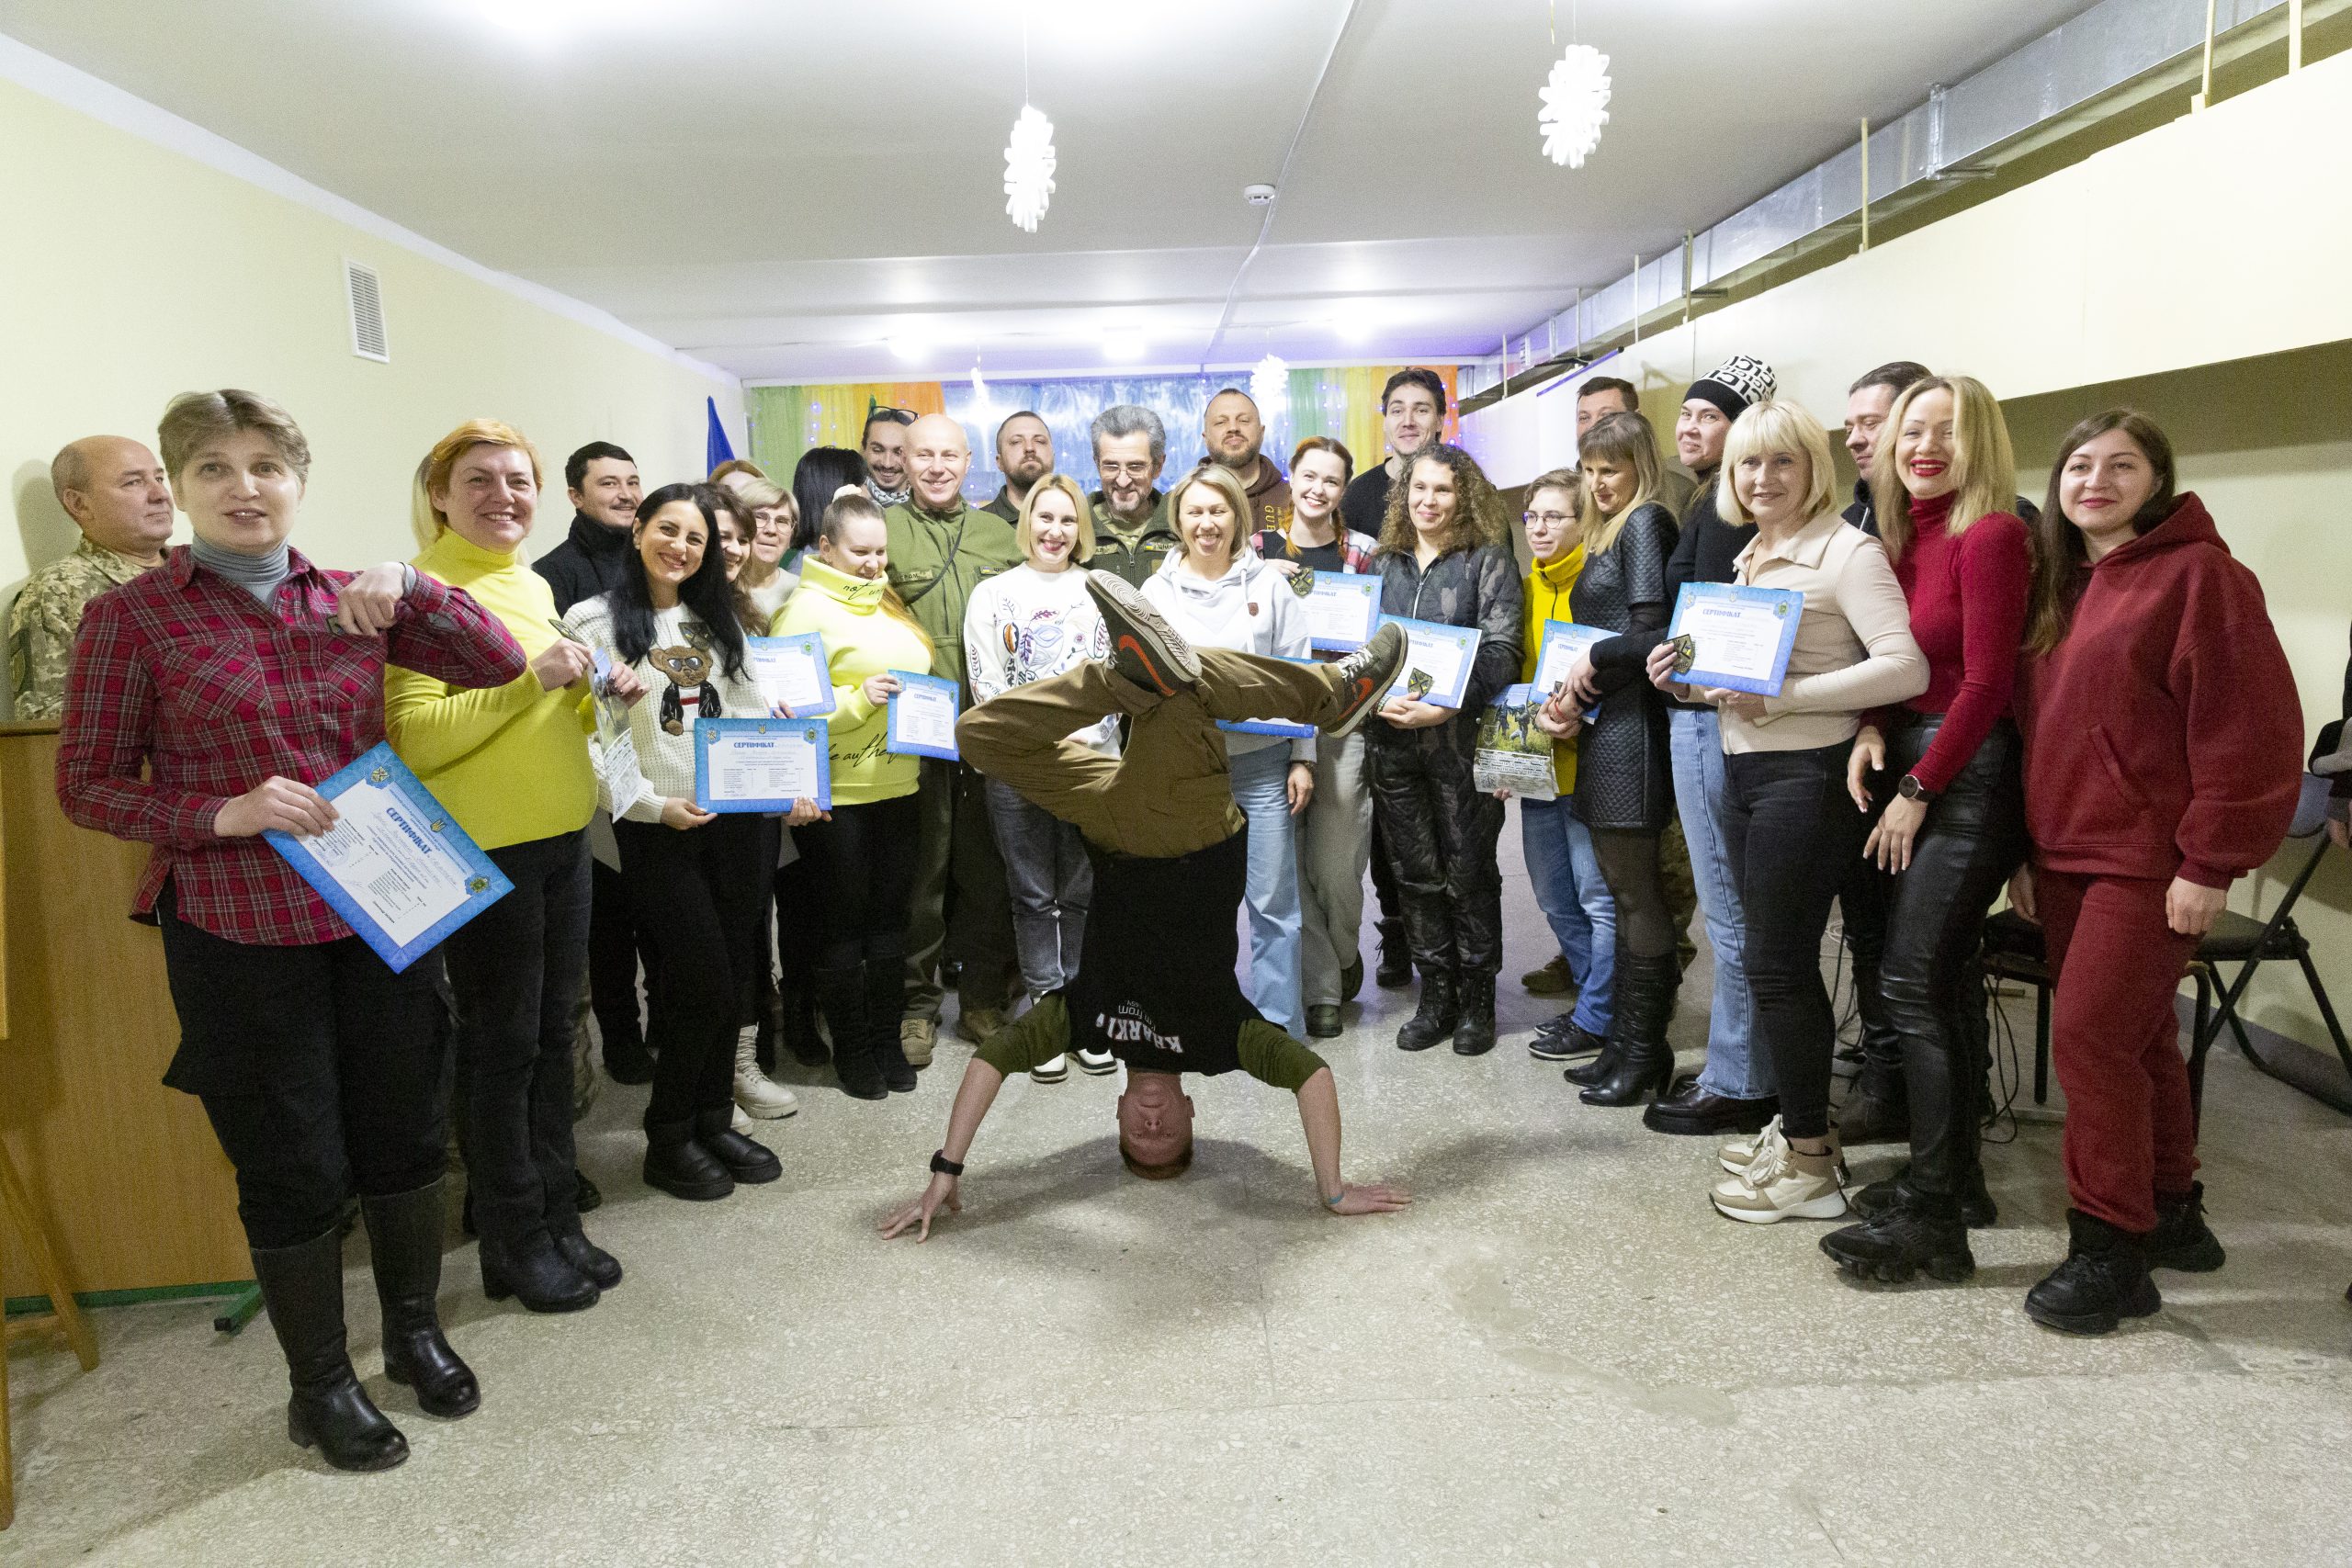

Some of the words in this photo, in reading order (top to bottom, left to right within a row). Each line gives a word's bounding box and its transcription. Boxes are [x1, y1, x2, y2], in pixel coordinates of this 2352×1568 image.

[1702, 609, 1741, 618] СЕРТИФІКАТ
[386, 807, 432, 854] СЕРТИФІКАТ
[1118, 1005, 1143, 1020] from
